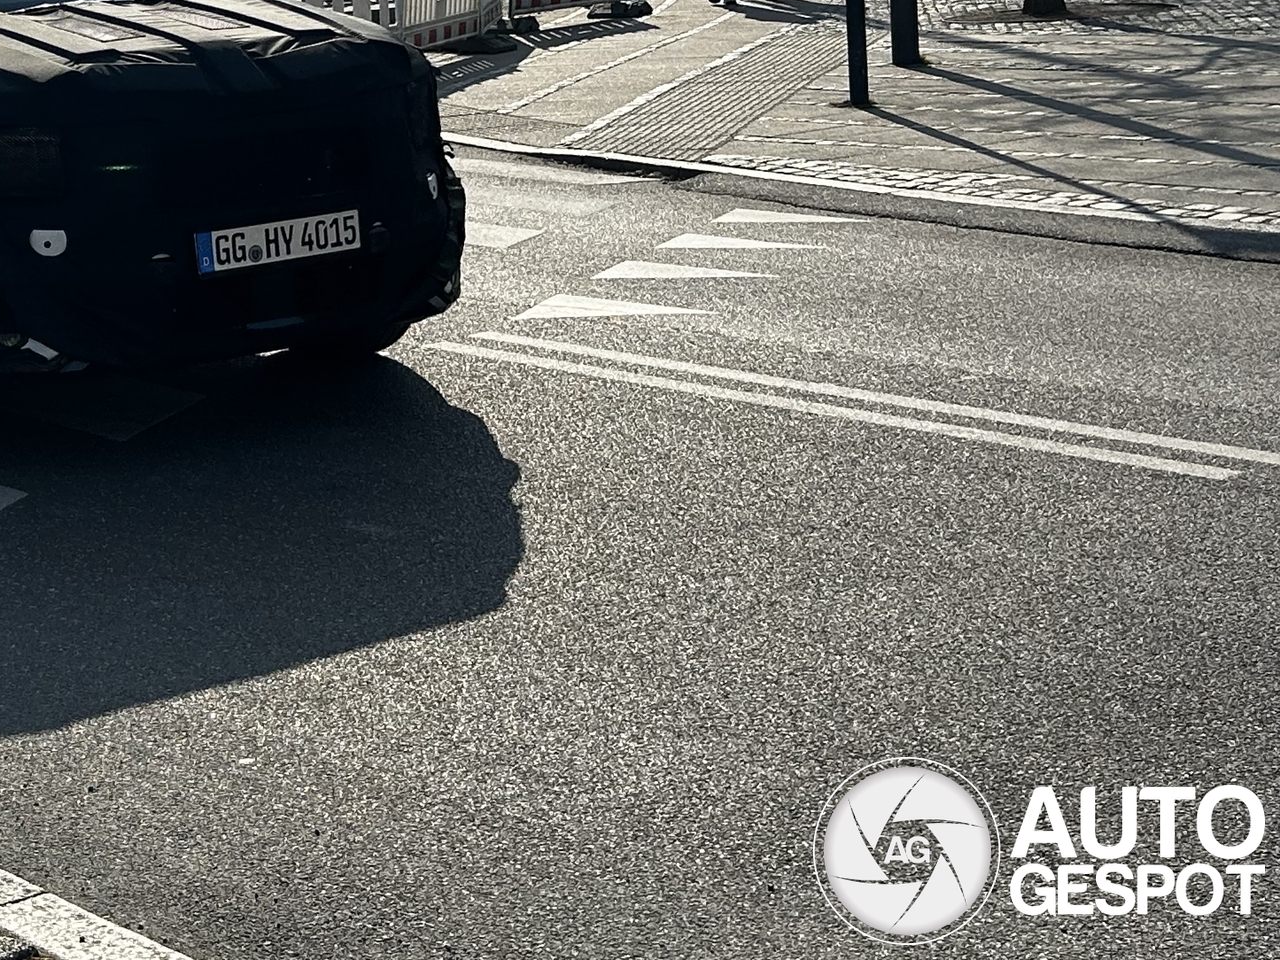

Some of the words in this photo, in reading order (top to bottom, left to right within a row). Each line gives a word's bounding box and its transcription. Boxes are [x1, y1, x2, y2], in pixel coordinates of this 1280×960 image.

[215, 232, 247, 265] GG
[264, 224, 294, 259] HY
[301, 215, 357, 252] 4015
[202, 256, 210, 267] D
